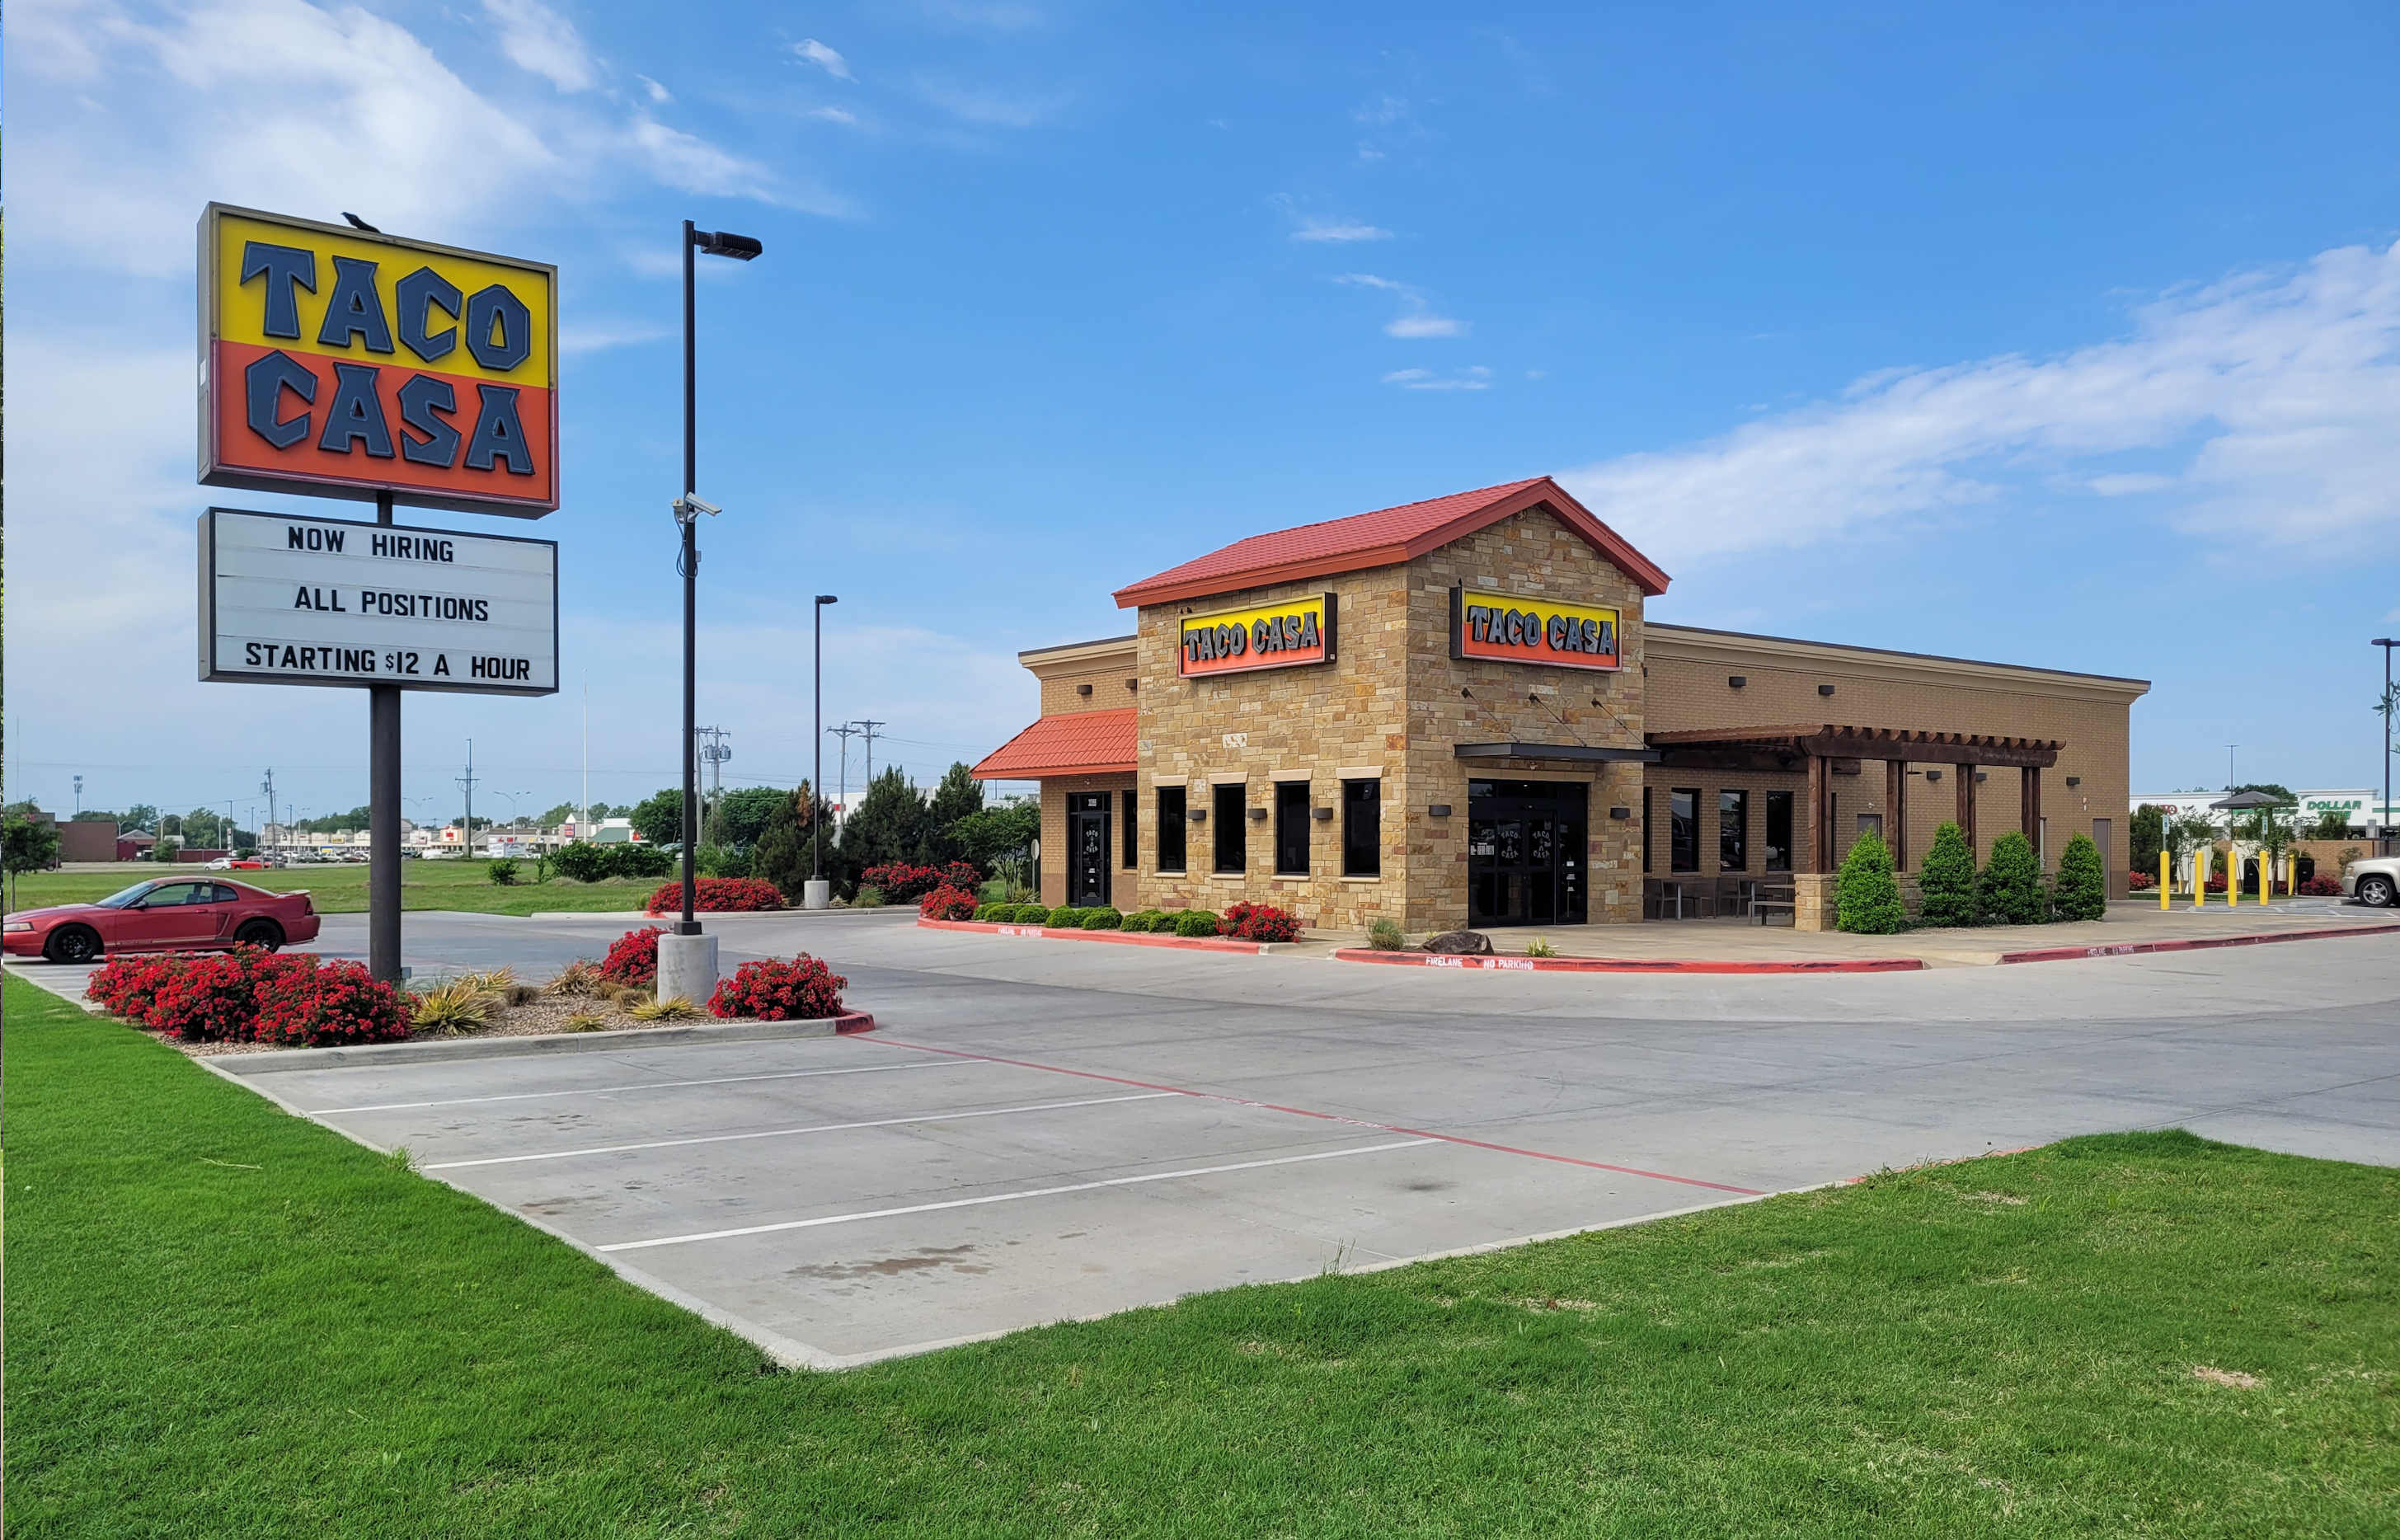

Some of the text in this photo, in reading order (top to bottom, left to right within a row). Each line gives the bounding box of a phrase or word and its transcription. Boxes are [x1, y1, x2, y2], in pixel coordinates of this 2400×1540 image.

[240, 240, 531, 371] TACO
[245, 349, 536, 475] CASA
[288, 526, 454, 563] NOW HIRING
[294, 586, 489, 622] ALL POSITIONS
[1183, 611, 1320, 661] TACO CASA
[1467, 605, 1616, 655] TACO CASA
[246, 642, 530, 681] STARTING $12 A HOUR
[2307, 800, 2362, 810] DOLLAR
[1483, 959, 1496, 970] NO
[1498, 959, 1533, 970] PARKING
